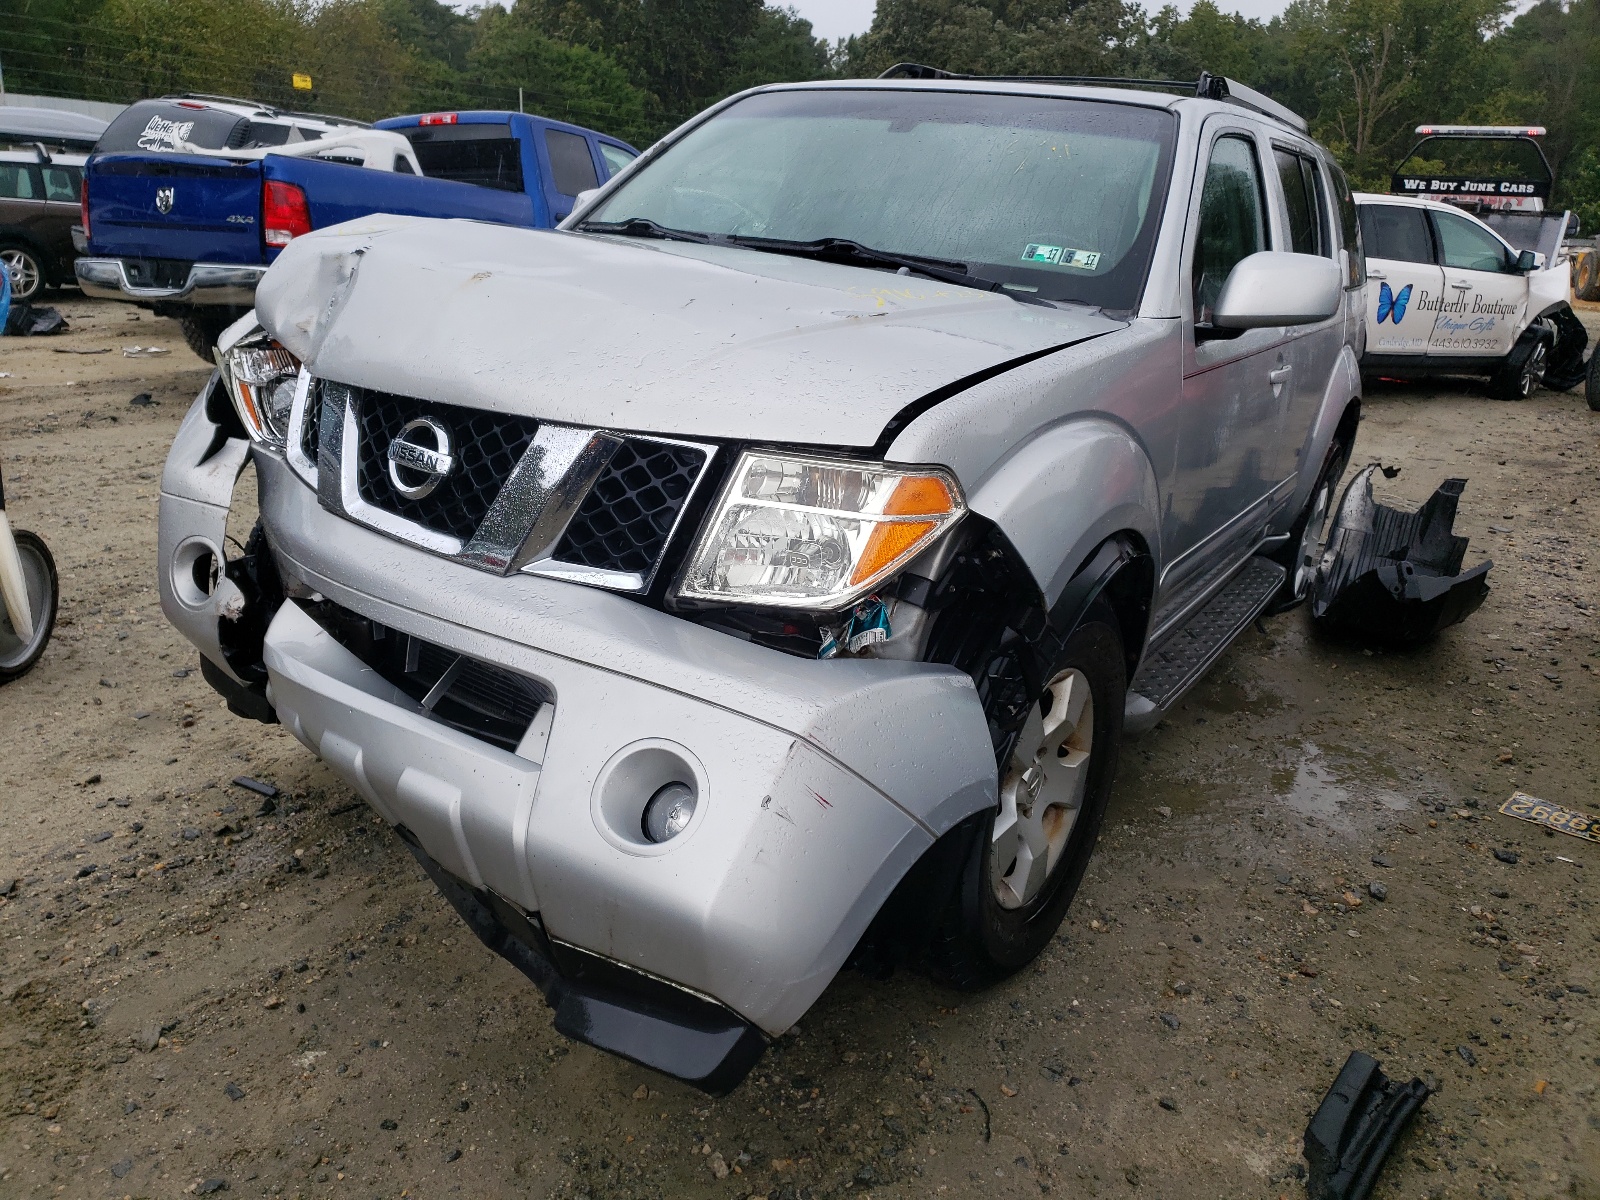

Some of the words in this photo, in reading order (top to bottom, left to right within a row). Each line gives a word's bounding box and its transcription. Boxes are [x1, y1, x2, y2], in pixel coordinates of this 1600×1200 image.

[1404, 179, 1426, 190] WE
[1430, 180, 1458, 191] BUY
[1461, 181, 1496, 192] JUNK
[1500, 182, 1535, 193] CARS
[1047, 248, 1060, 261] 17
[1065, 252, 1075, 264] 5
[1084, 253, 1097, 266] 17
[1416, 290, 1470, 318] Butterfly
[1471, 293, 1518, 321] Boutique
[1431, 337, 1498, 350] 443.610.3932
[388, 440, 440, 473] NISSAN
